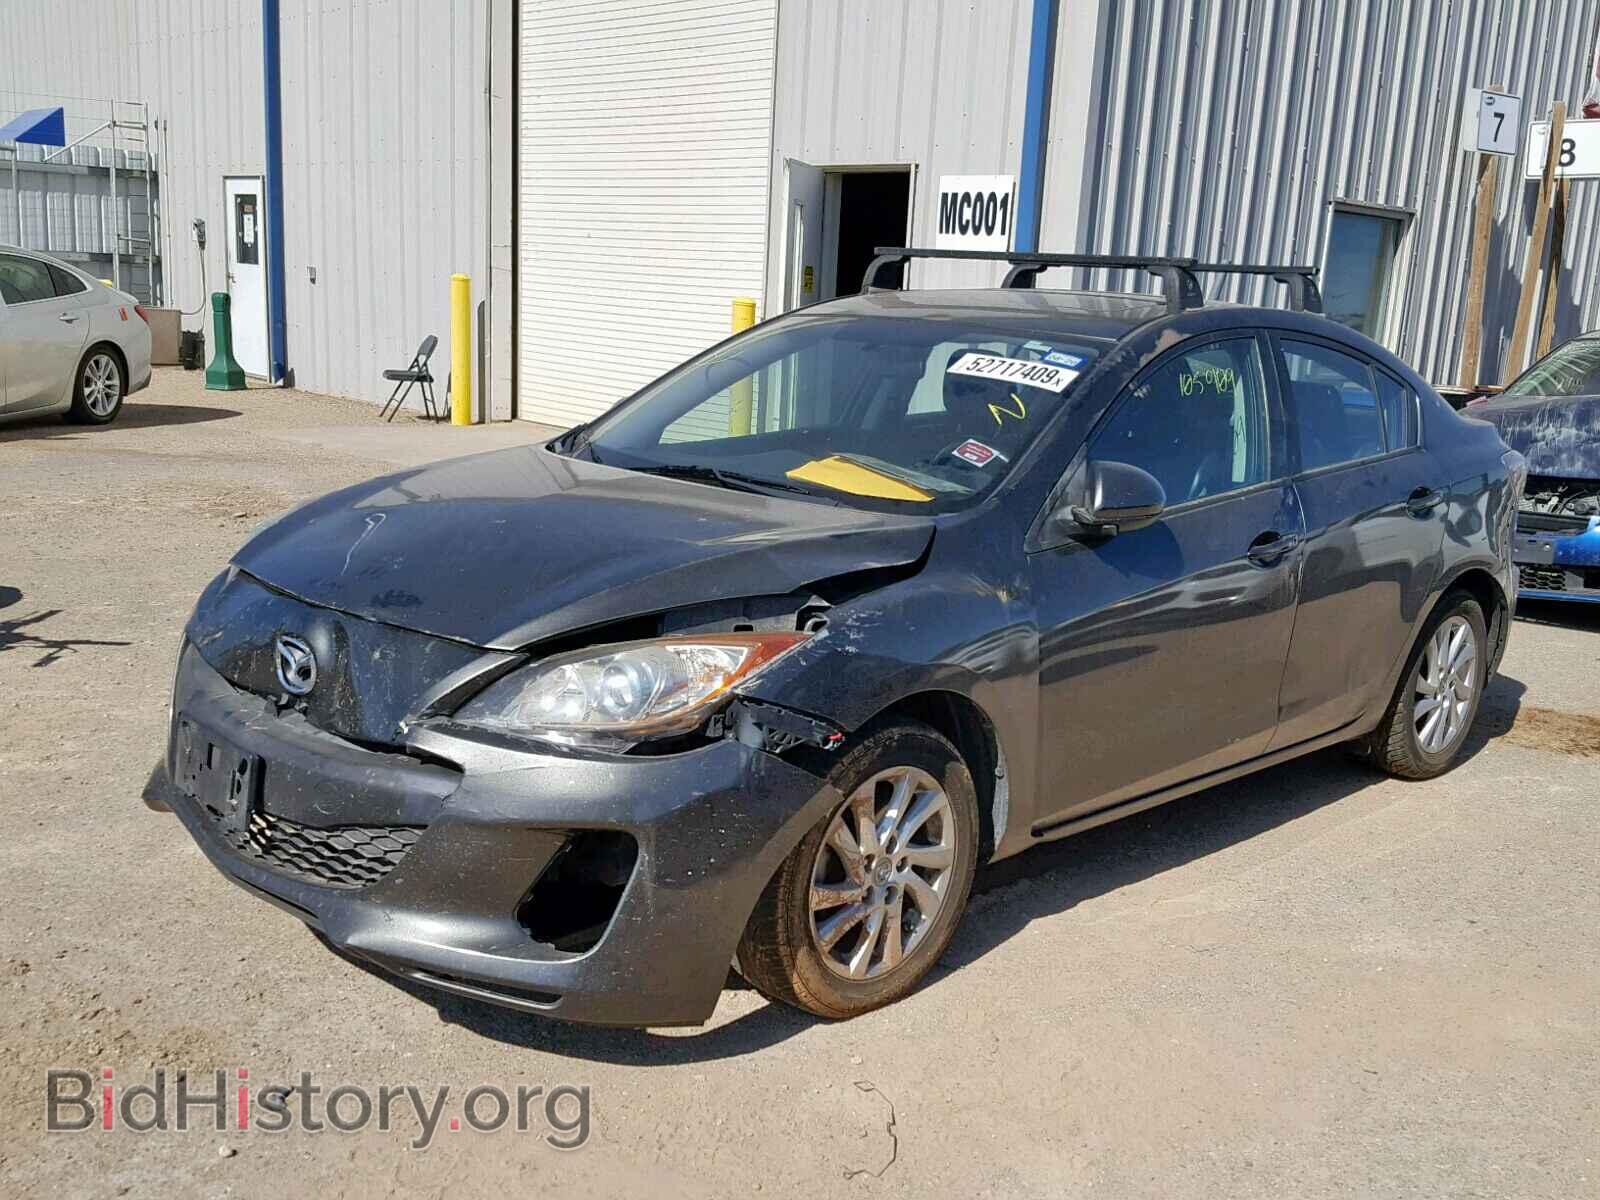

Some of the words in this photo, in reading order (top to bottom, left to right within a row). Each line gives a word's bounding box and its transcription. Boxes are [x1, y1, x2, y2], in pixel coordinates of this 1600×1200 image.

[1493, 112, 1505, 142] 7
[1558, 138, 1576, 167] 8
[939, 191, 1009, 236] MC001
